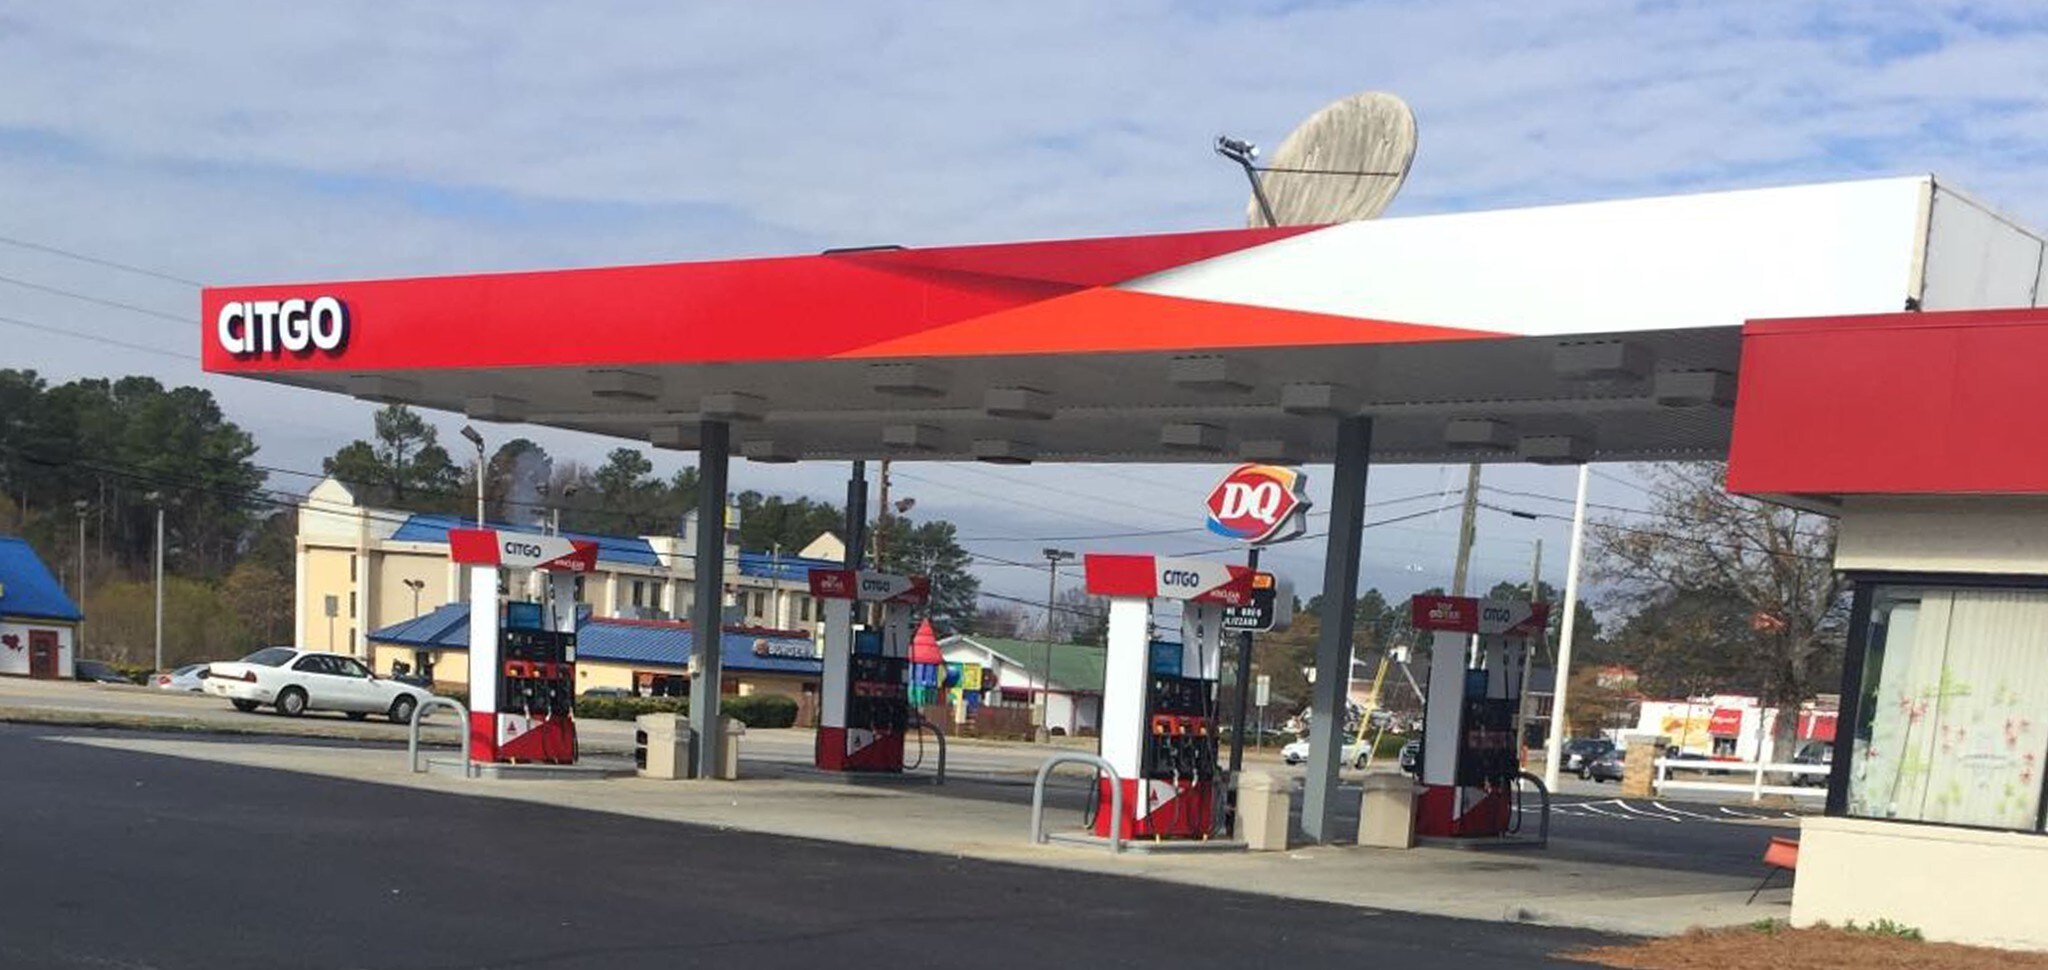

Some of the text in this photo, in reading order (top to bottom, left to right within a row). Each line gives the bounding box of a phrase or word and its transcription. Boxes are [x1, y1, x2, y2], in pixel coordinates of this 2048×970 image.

[218, 296, 345, 354] CITGO
[1219, 481, 1282, 525] DQ
[505, 541, 541, 558] CITGO
[862, 578, 890, 593] CITGO
[1163, 569, 1200, 588] CITGO
[1483, 608, 1511, 622] CITGO
